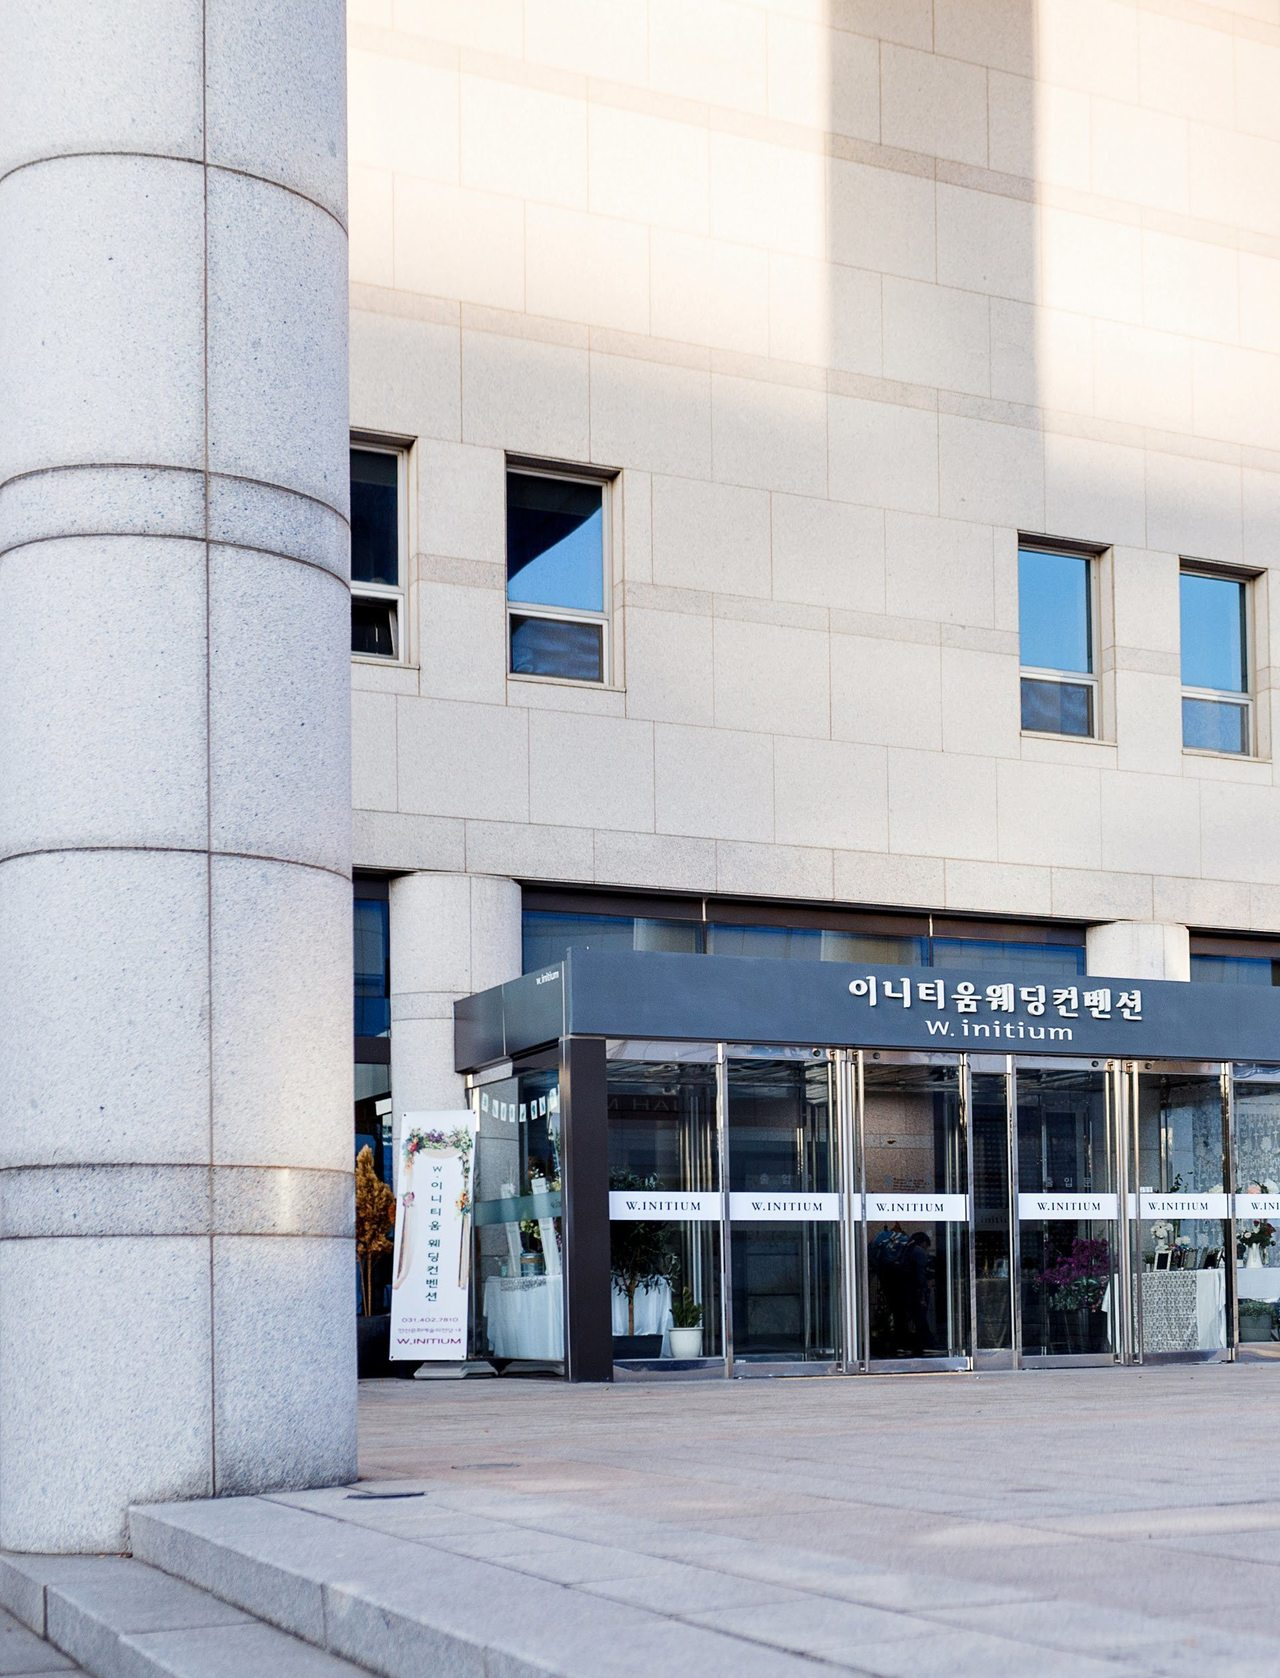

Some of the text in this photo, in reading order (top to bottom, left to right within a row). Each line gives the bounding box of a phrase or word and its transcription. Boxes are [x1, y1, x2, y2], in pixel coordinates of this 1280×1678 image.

[848, 975, 1144, 1021] 이니티움웨딩컨벤션
[625, 1201, 701, 1211] W.INITIUM
[751, 1202, 823, 1212] W.INITIUM
[876, 1203, 944, 1212] W.INITIUM
[1037, 1202, 1102, 1211] W.INITIUM
[1148, 1202, 1209, 1211] W.INITIUM
